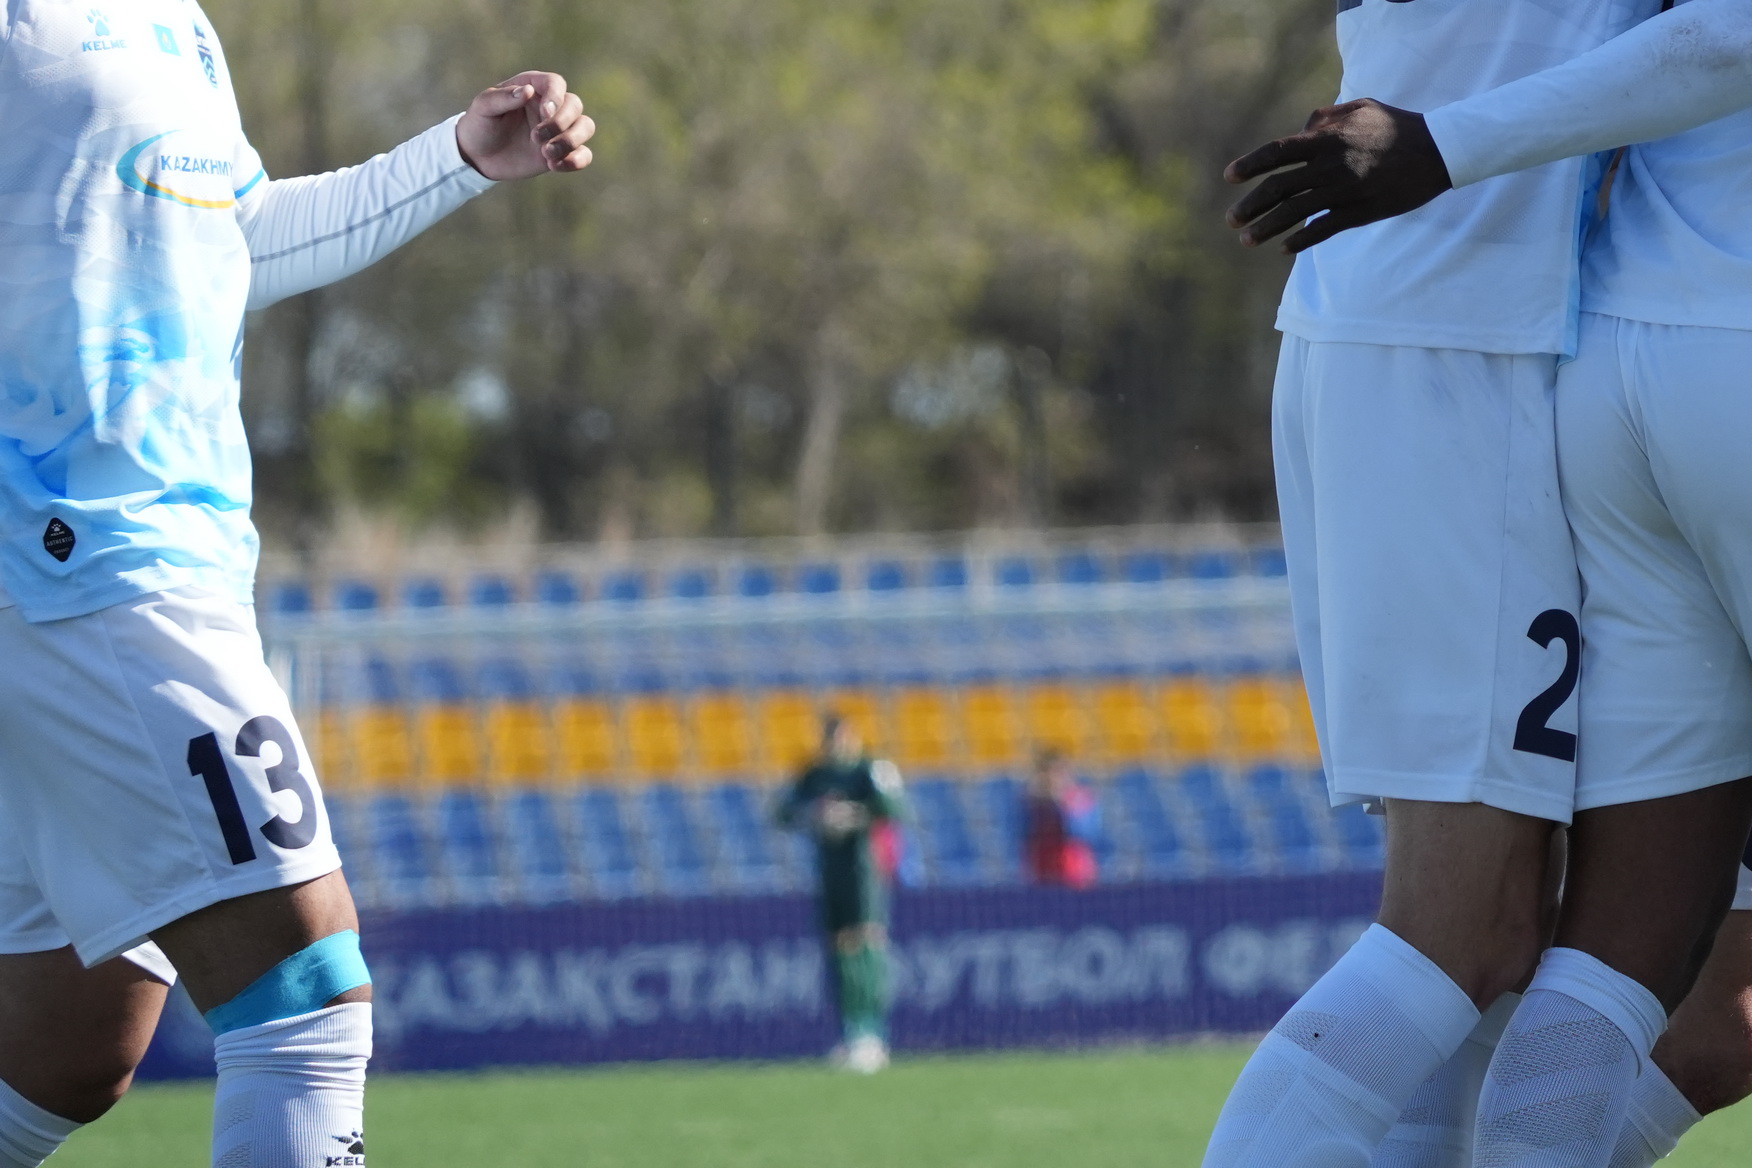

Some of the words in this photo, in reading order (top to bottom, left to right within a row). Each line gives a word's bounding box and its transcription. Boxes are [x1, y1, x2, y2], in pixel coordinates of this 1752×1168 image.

[82, 39, 128, 52] KELME
[1513, 609, 1581, 762] 2
[186, 715, 317, 865] 13
[326, 1156, 365, 1167] KEL
